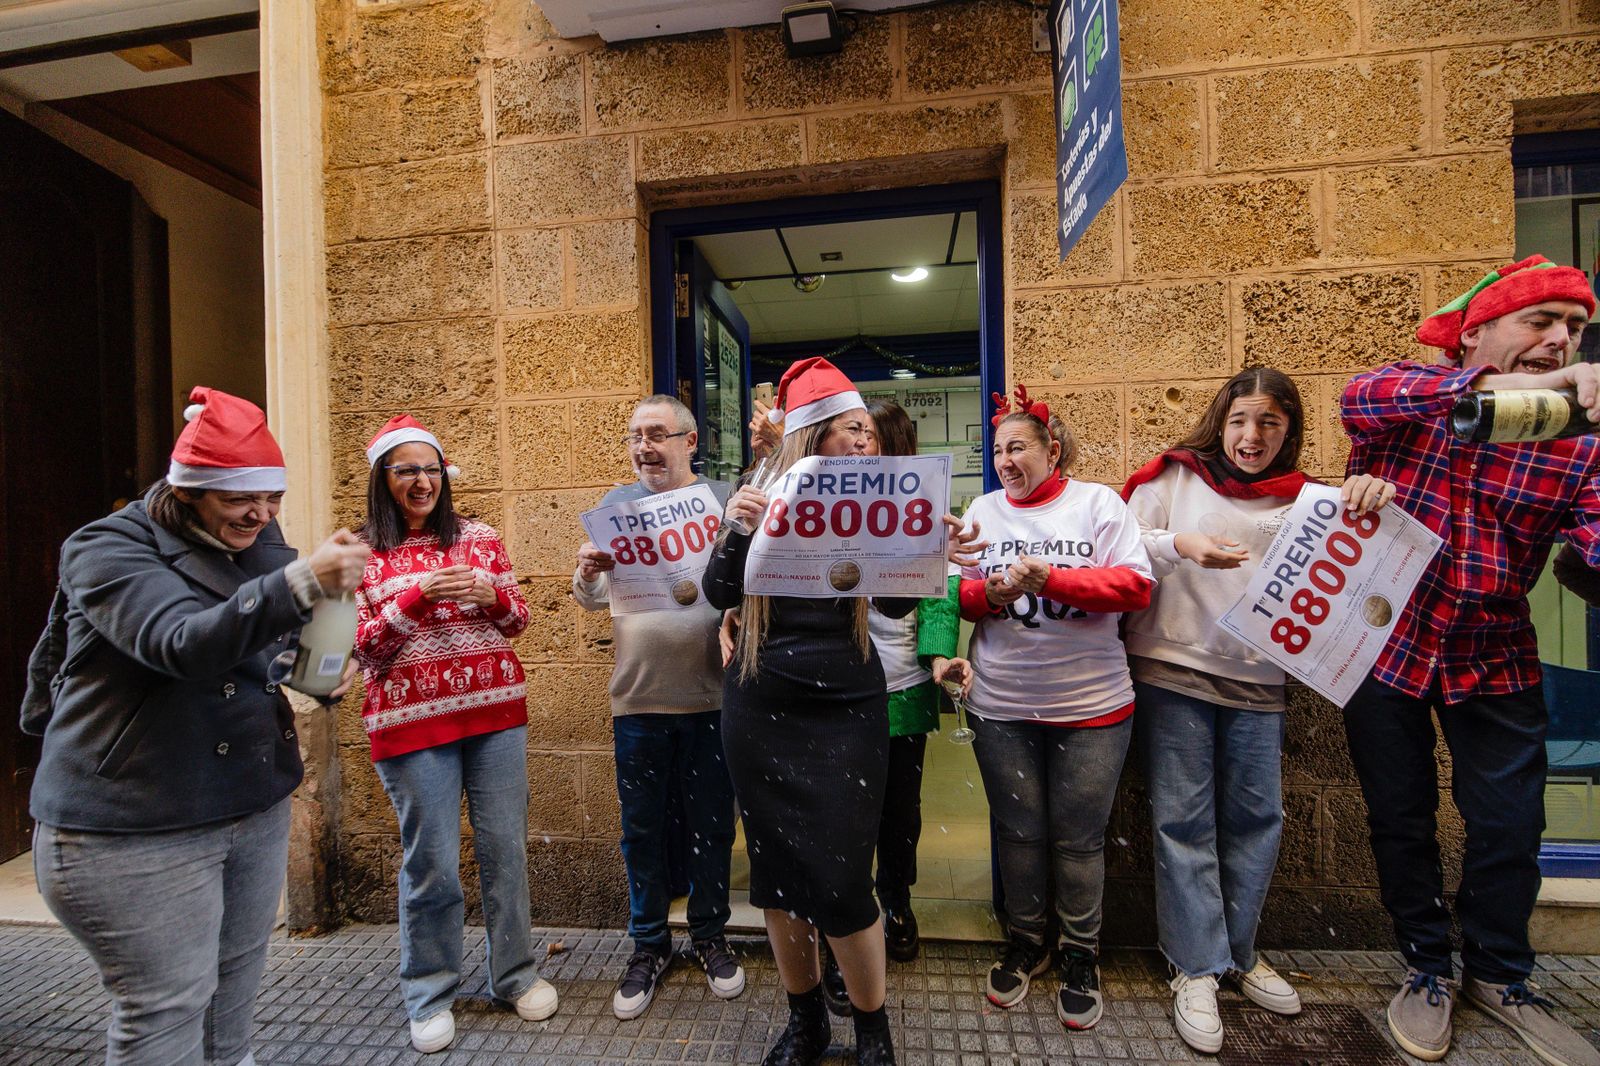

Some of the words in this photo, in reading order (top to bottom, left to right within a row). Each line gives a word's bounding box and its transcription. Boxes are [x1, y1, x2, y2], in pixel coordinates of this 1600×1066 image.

[1062, 121, 1090, 182] Loterías
[1090, 106, 1098, 135] y
[1064, 142, 1098, 209] Apuestas
[1099, 110, 1112, 152] del
[1063, 192, 1088, 238] Estado
[904, 397, 942, 408] 87092
[797, 472, 920, 495] PREMIO
[818, 459, 856, 467] VENDIDO
[858, 457, 880, 467] AQUÍ
[624, 496, 706, 532] PREMIO
[764, 498, 933, 538] 88008
[610, 514, 720, 566] 88008
[1000, 540, 1094, 558] PREMIO
[1262, 538, 1284, 569] VENDIDO
[1280, 522, 1294, 540] AQUÍ
[1264, 498, 1337, 604] PREMIO
[1270, 508, 1380, 655] 88008
[1391, 576, 1397, 584] 22
[1397, 545, 1416, 576] DICIEMBRE
[1330, 663, 1348, 687] LOTERÍA
[1351, 631, 1368, 657] NAVIDAD
